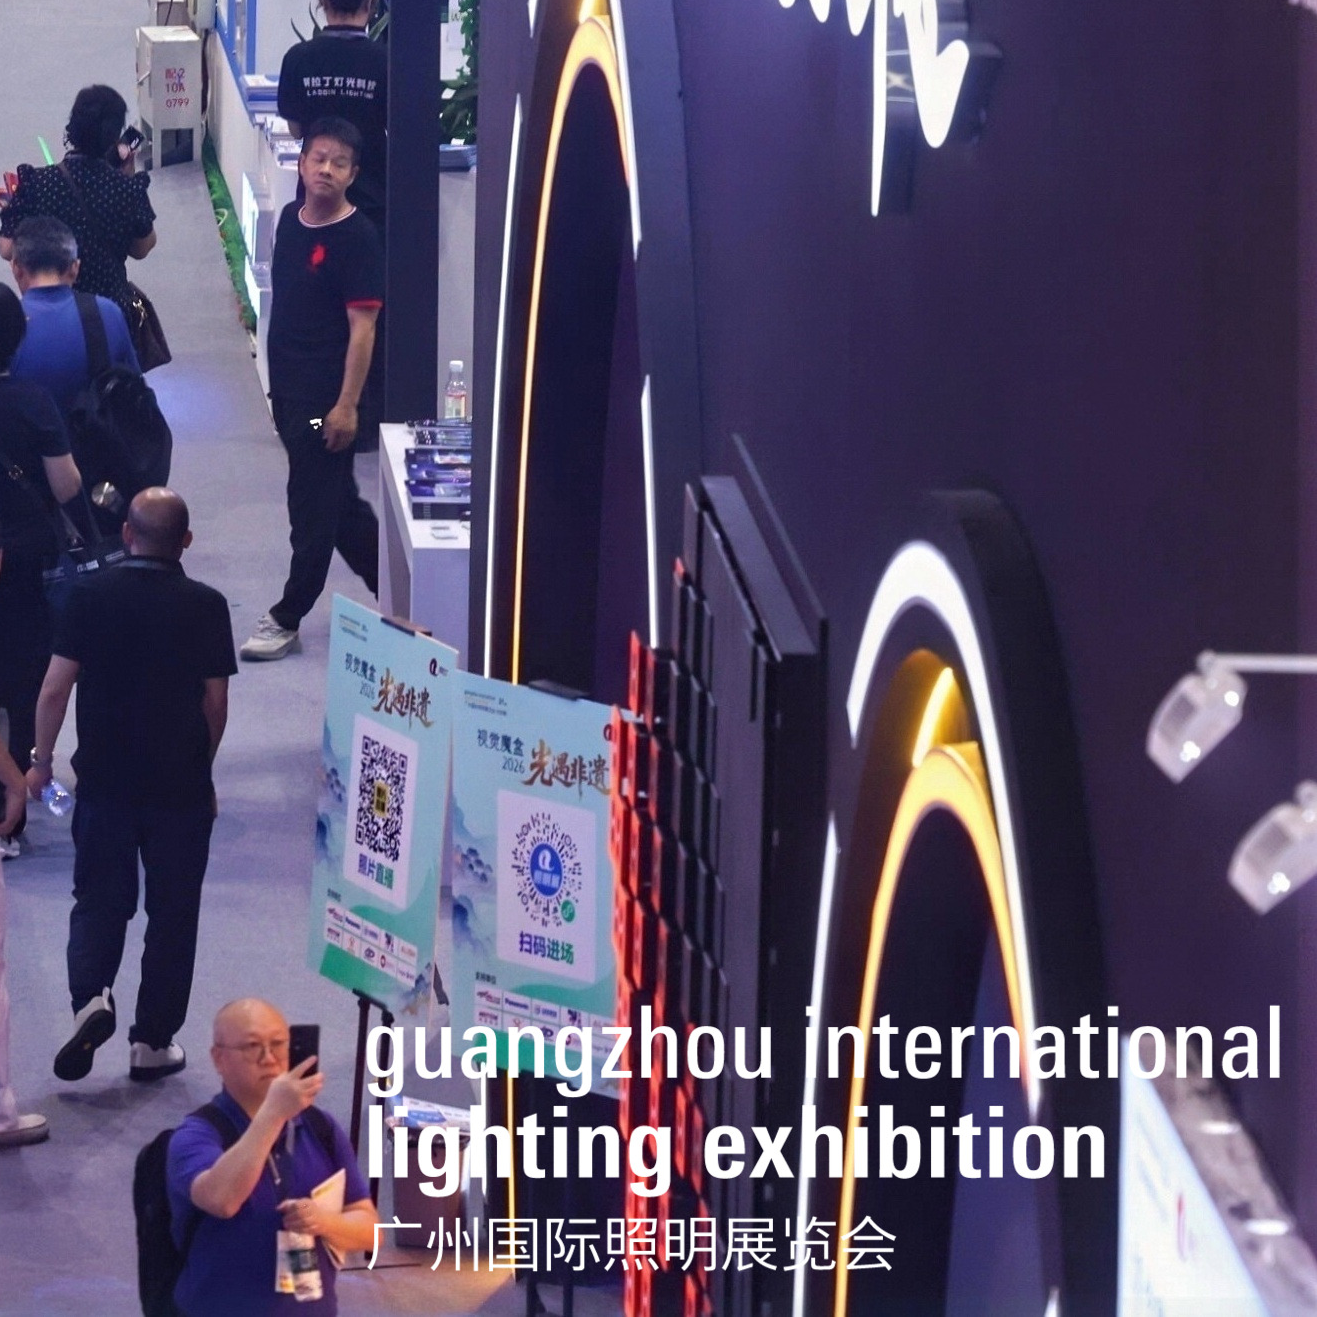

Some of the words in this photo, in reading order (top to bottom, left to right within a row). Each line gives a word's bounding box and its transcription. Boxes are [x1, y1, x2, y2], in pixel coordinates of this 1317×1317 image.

[502, 756, 526, 775] 2026
[518, 931, 575, 965] 扫码进场
